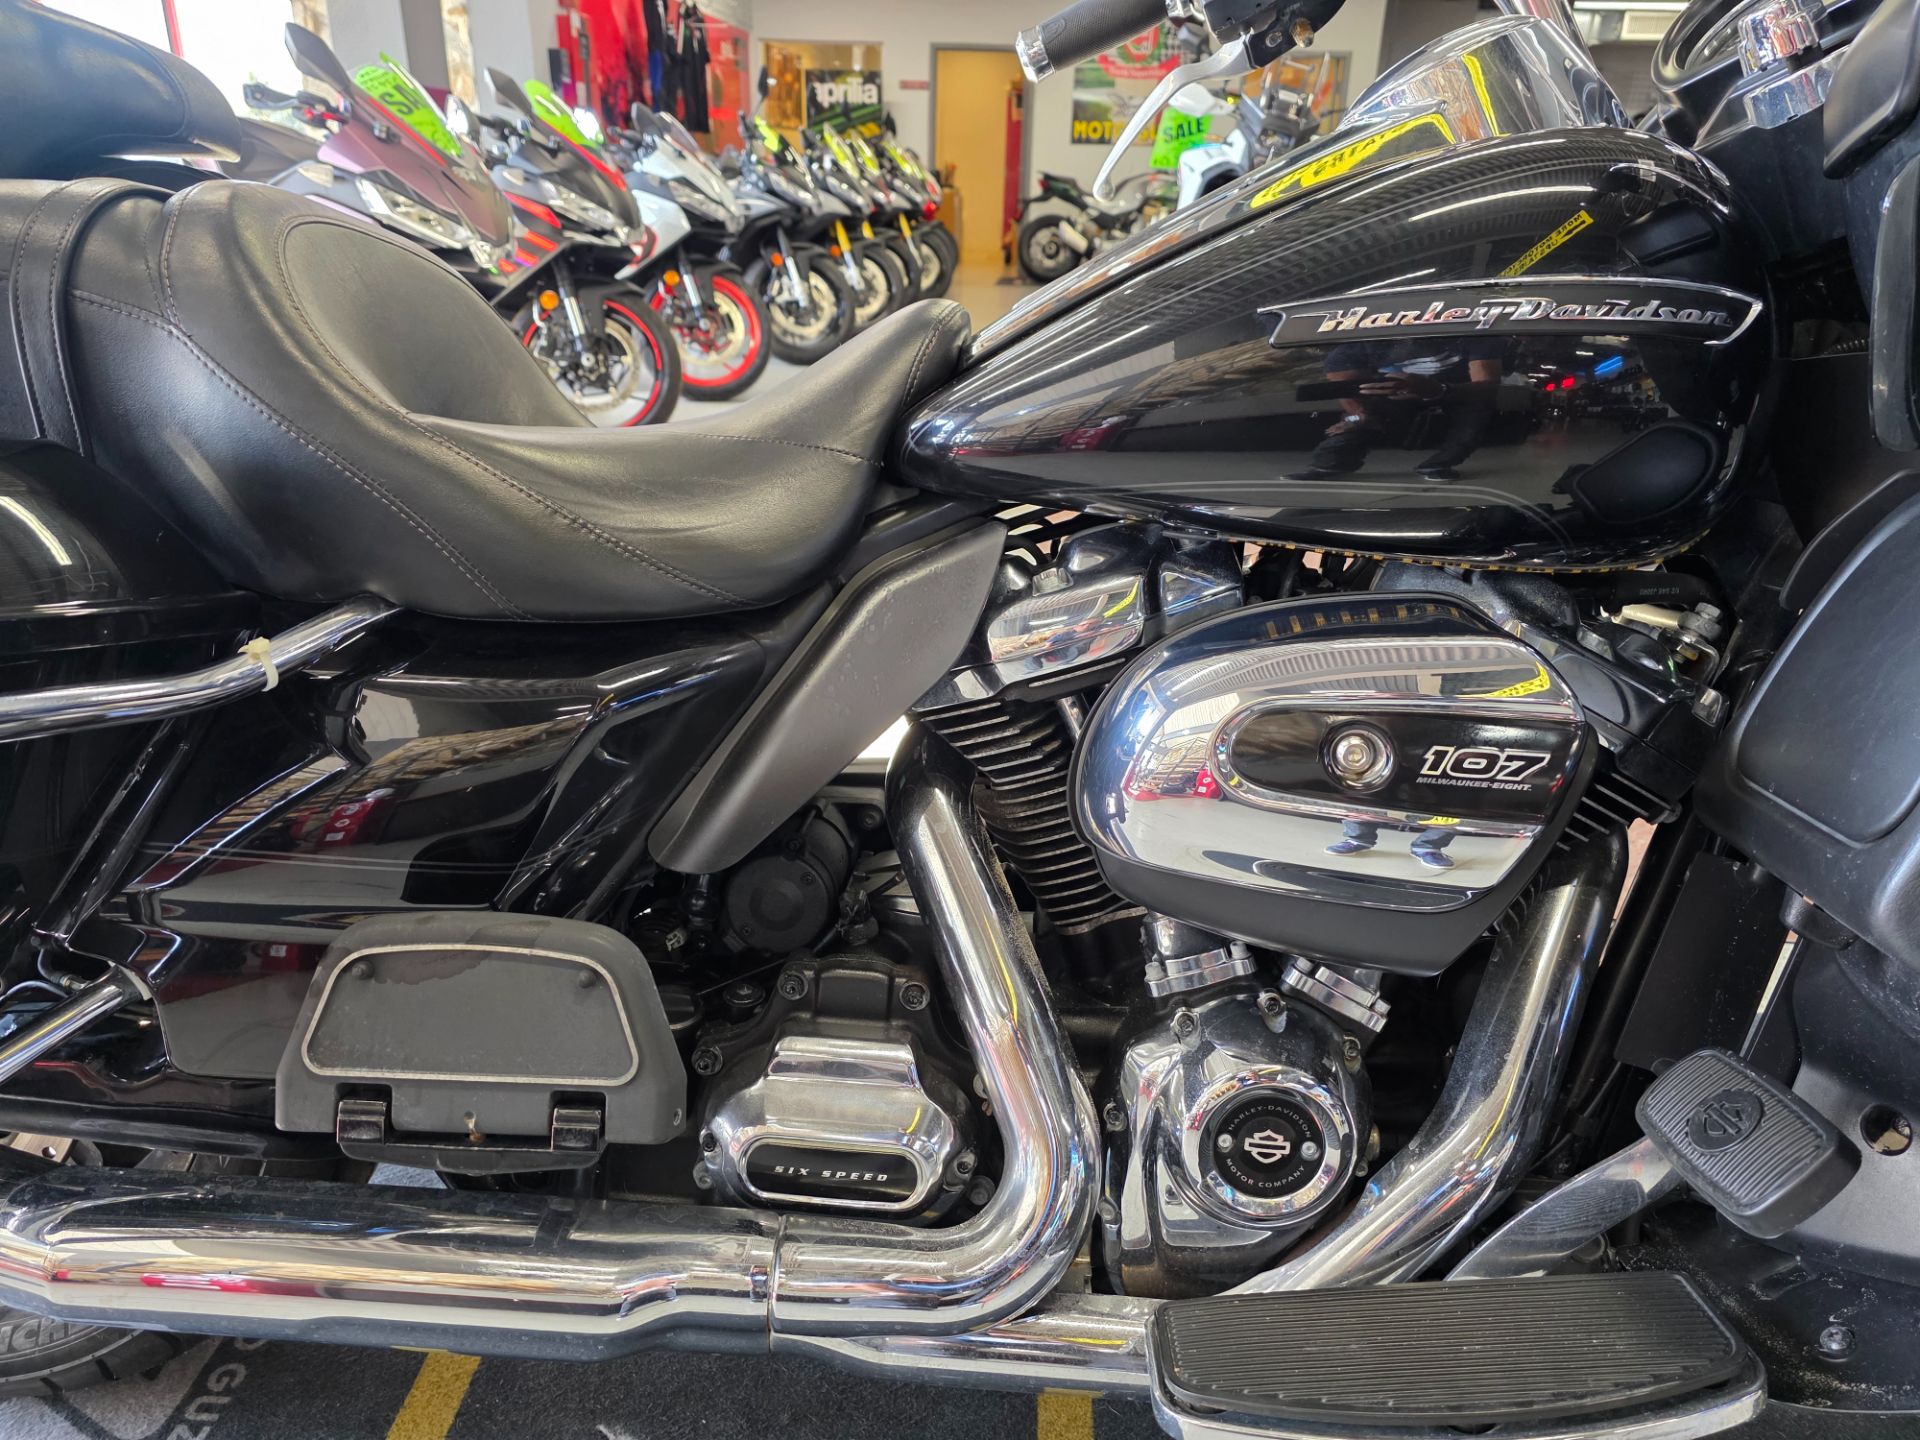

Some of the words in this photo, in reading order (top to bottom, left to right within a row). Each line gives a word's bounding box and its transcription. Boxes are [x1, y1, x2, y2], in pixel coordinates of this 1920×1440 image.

[1163, 116, 1207, 144] SALE
[1419, 745, 1552, 781] 107
[1228, 1104, 1313, 1139] HARLEY-DAVIDSON
[774, 1165, 811, 1176] SIX
[821, 1170, 889, 1182] SPEED
[1226, 1158, 1255, 1186] MOTOR
[1258, 1165, 1305, 1188] COMPANY
